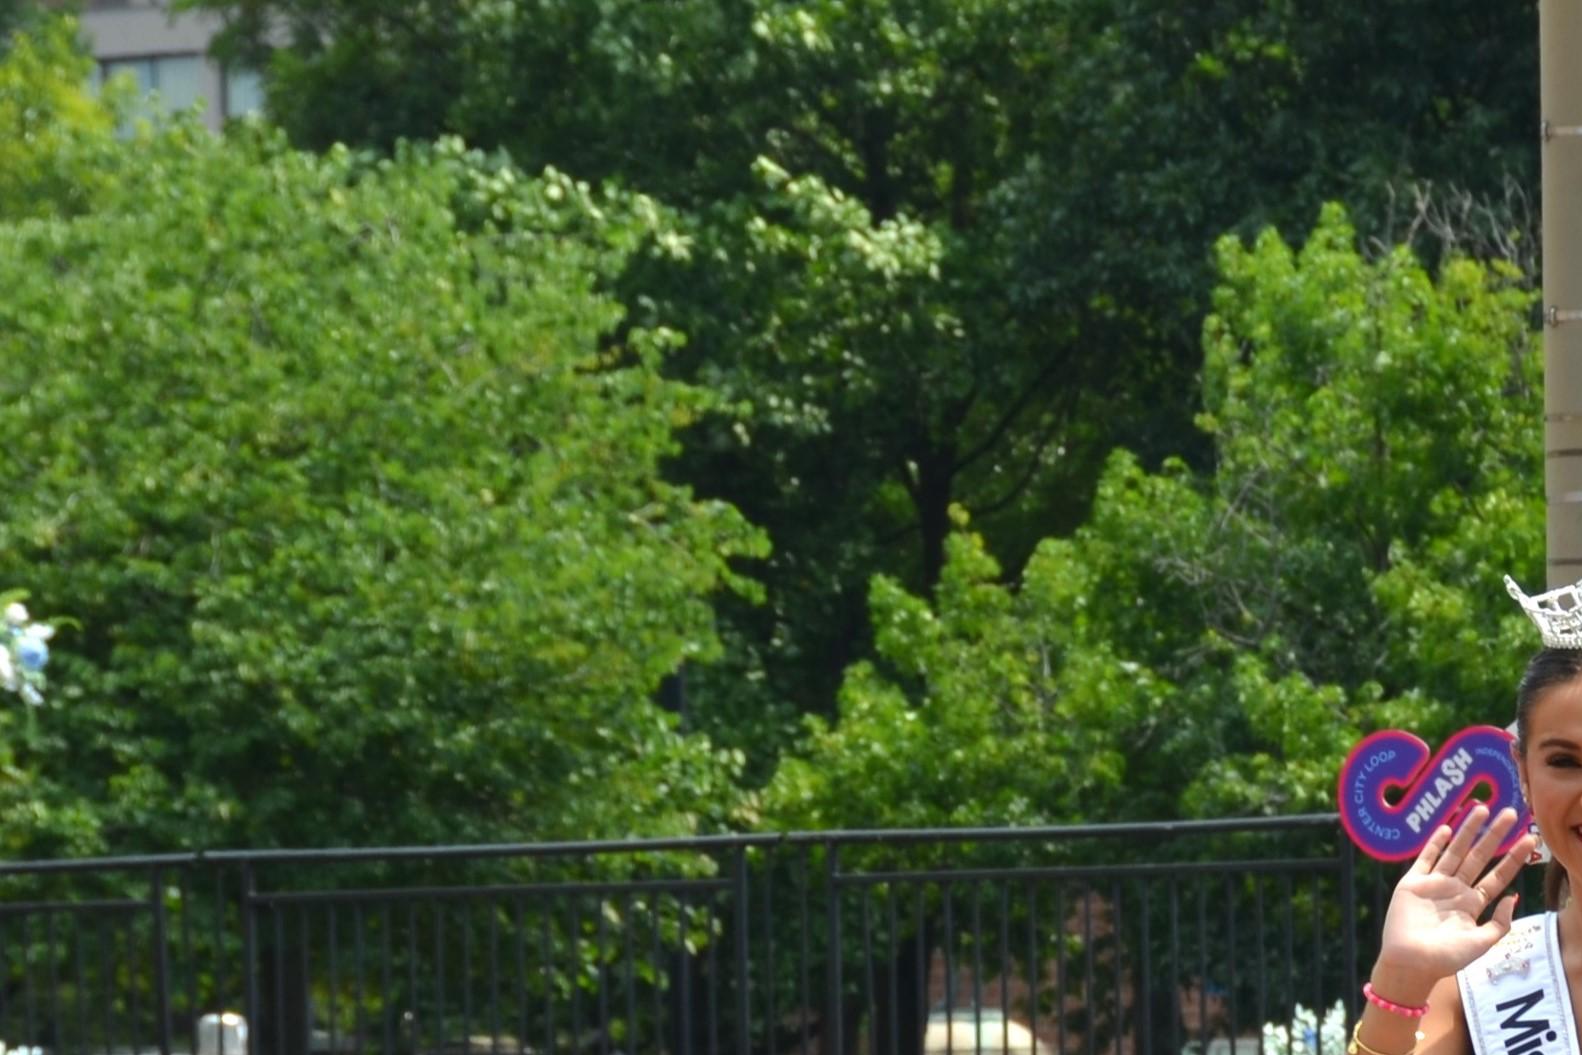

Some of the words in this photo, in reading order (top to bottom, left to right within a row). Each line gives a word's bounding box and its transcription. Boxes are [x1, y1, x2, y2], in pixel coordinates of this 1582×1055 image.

[1364, 749, 1397, 773] LOOP
[1354, 770, 1367, 805] CITY
[1405, 747, 1474, 833] PHLASH
[1358, 806, 1401, 840] CENTER
